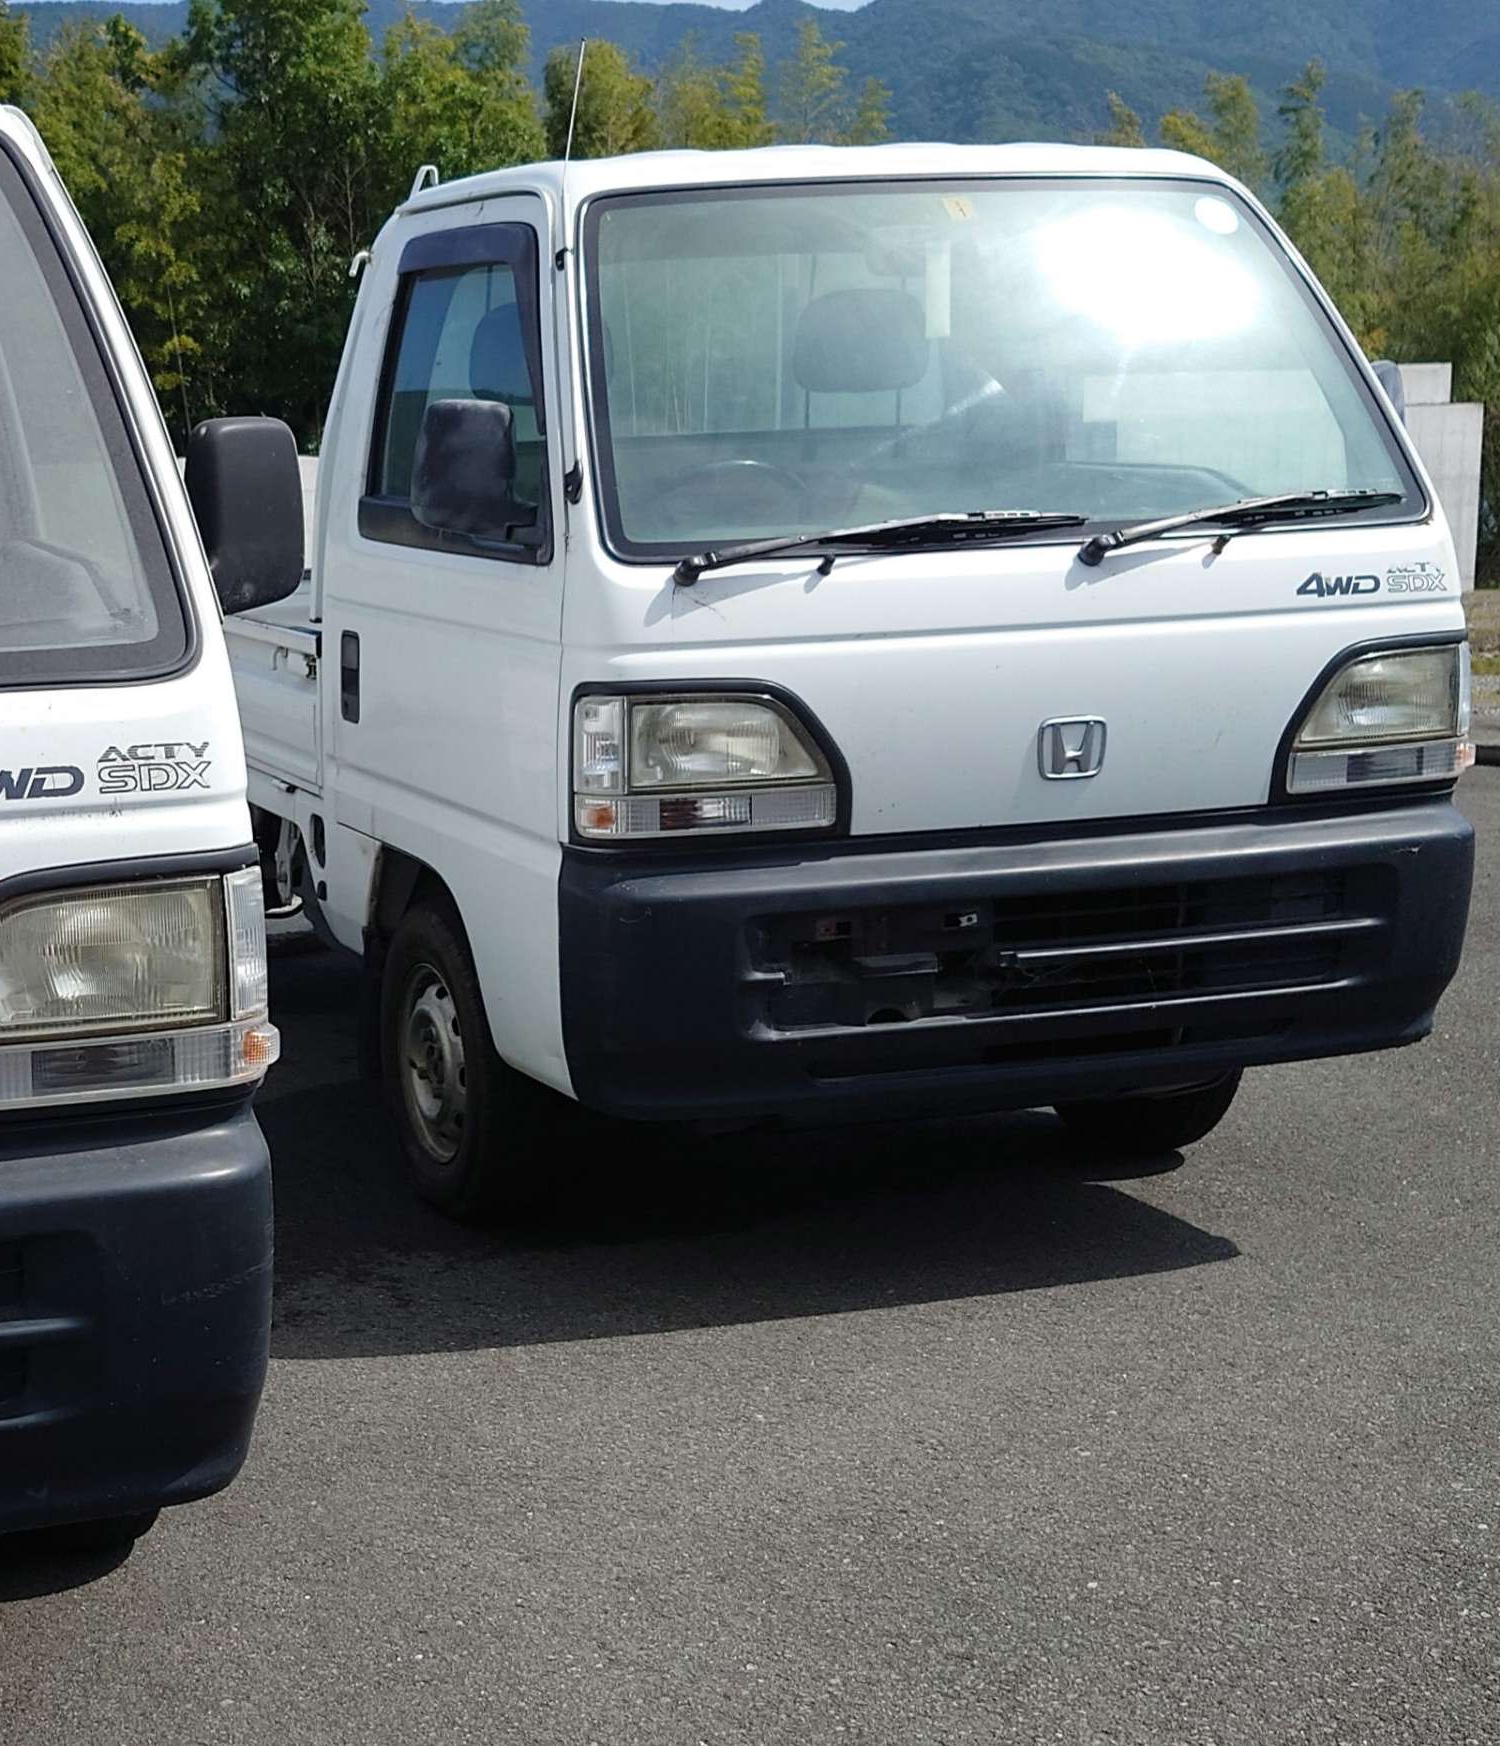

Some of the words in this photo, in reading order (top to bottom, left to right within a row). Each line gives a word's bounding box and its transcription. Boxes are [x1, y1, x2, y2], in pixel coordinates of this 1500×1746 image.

[1296, 571, 1381, 598] 4WD
[1386, 573, 1448, 593] SDX
[97, 741, 210, 763] ACTY
[97, 761, 212, 795] SDX
